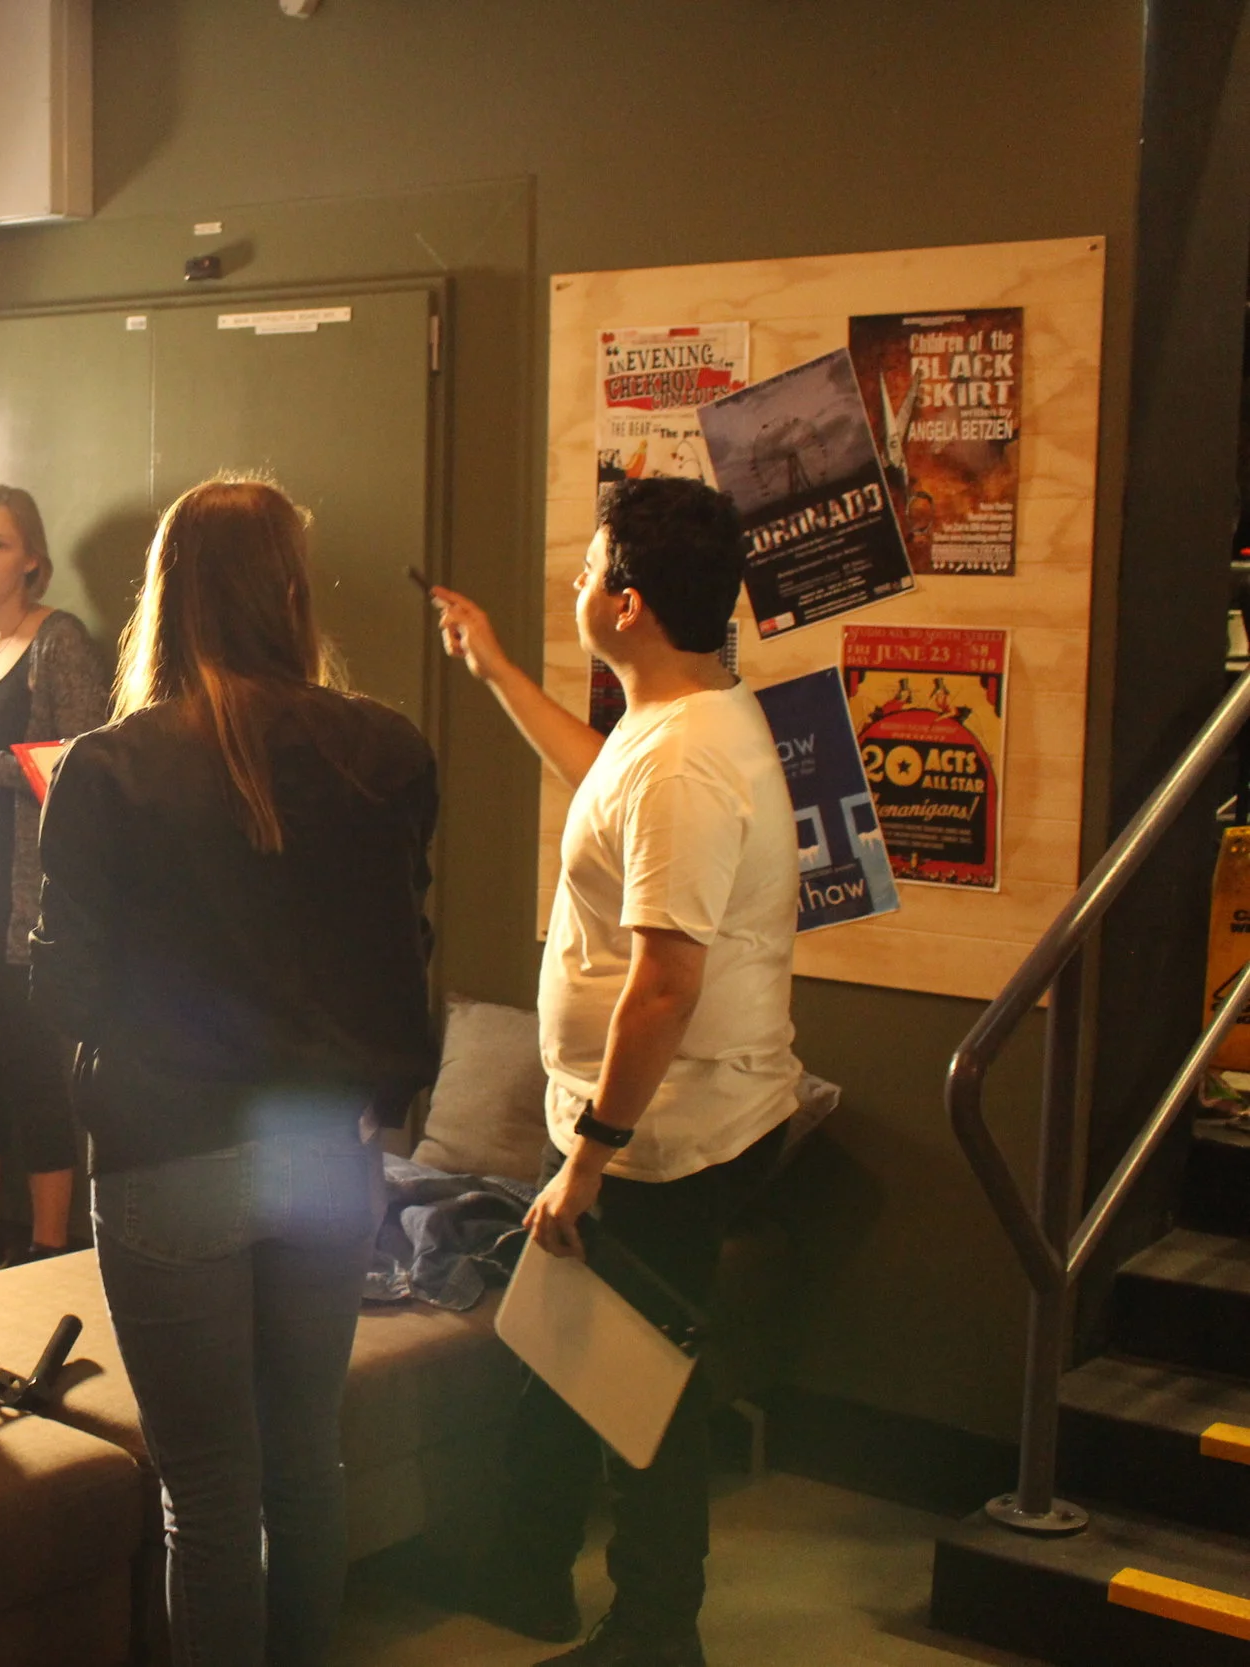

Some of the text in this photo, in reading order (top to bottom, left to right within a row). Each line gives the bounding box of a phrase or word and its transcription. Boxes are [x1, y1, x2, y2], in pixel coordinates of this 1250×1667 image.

[910, 329, 1014, 353] Children of the
[626, 344, 714, 371] EVENING
[911, 353, 1014, 380] BLACK
[608, 368, 699, 401] CHEKHOV
[916, 380, 1014, 407] SKIRT
[660, 428, 678, 438] The
[907, 418, 1014, 442] ANGELA BETZIEN
[873, 644, 926, 665] JUNE
[930, 646, 950, 662] 23
[924, 748, 978, 774] ACTS
[921, 776, 985, 793] ALL STAR
[871, 792, 980, 821] henanigans!
